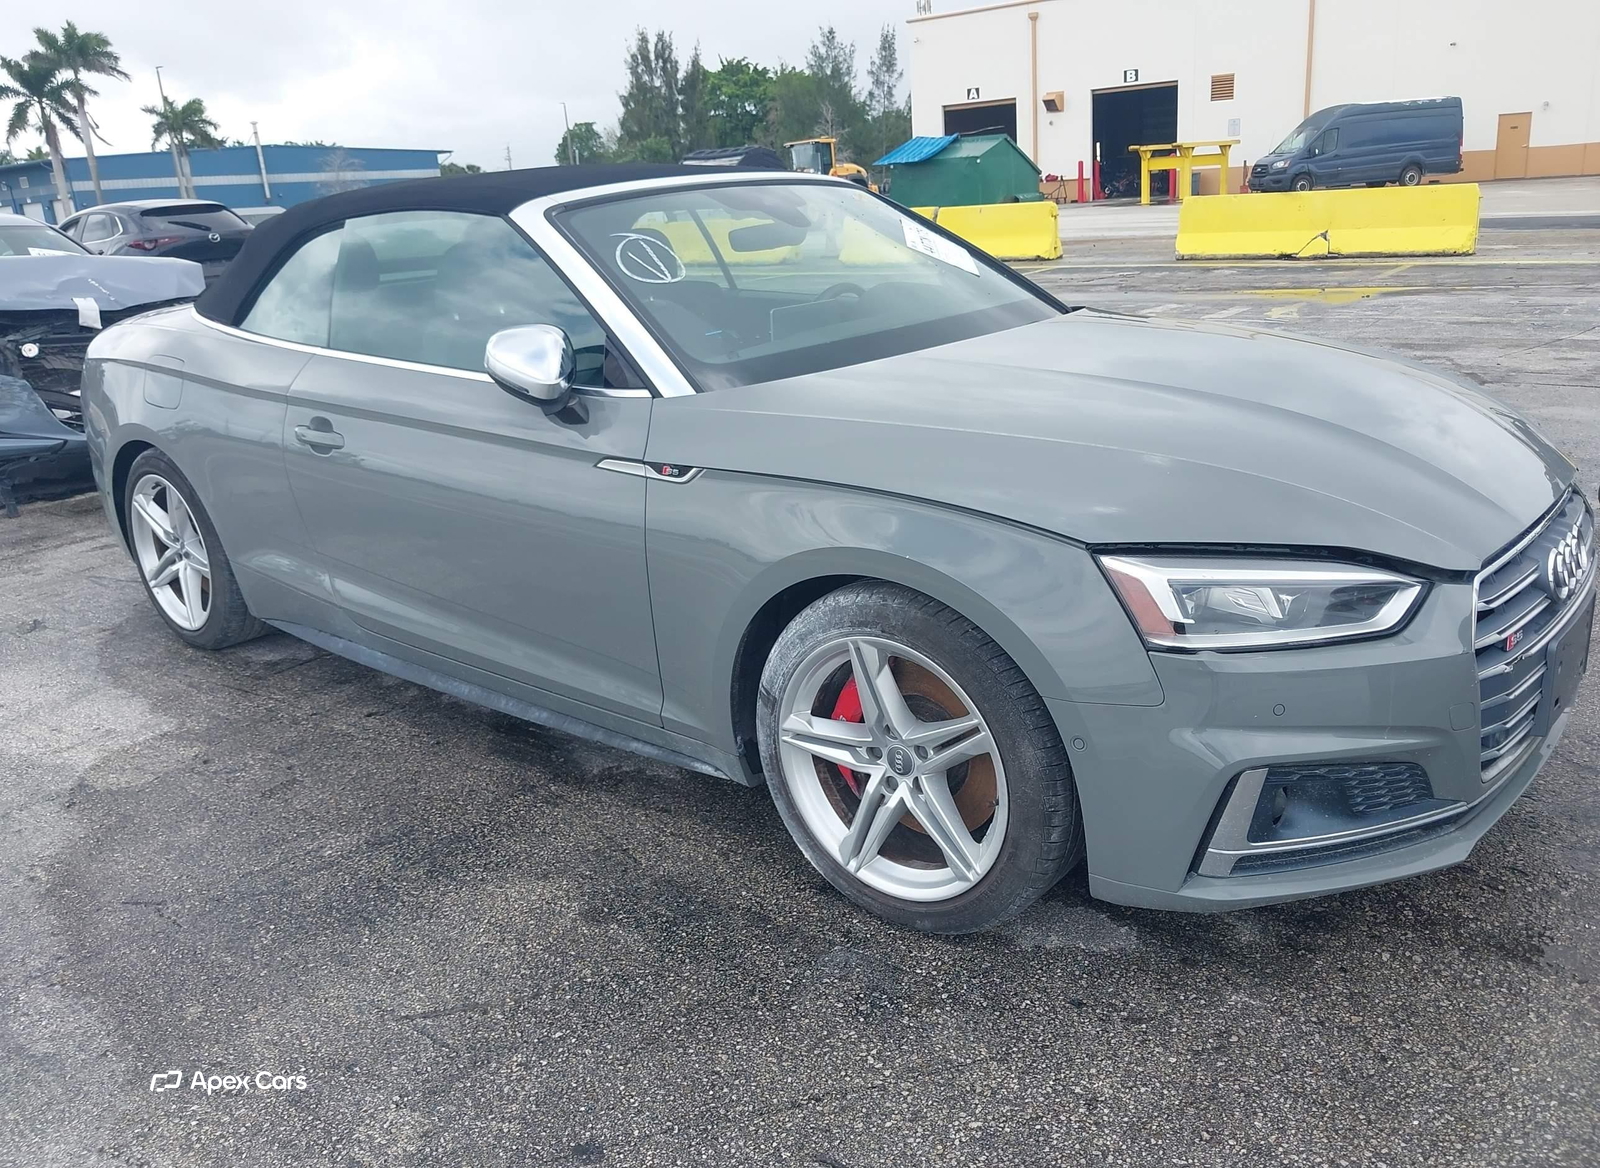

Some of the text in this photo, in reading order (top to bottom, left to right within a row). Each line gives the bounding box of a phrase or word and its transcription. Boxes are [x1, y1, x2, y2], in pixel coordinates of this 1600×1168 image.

[1126, 70, 1137, 82] B
[968, 88, 978, 100] A
[663, 466, 679, 476] S5
[1509, 630, 1523, 648] S5
